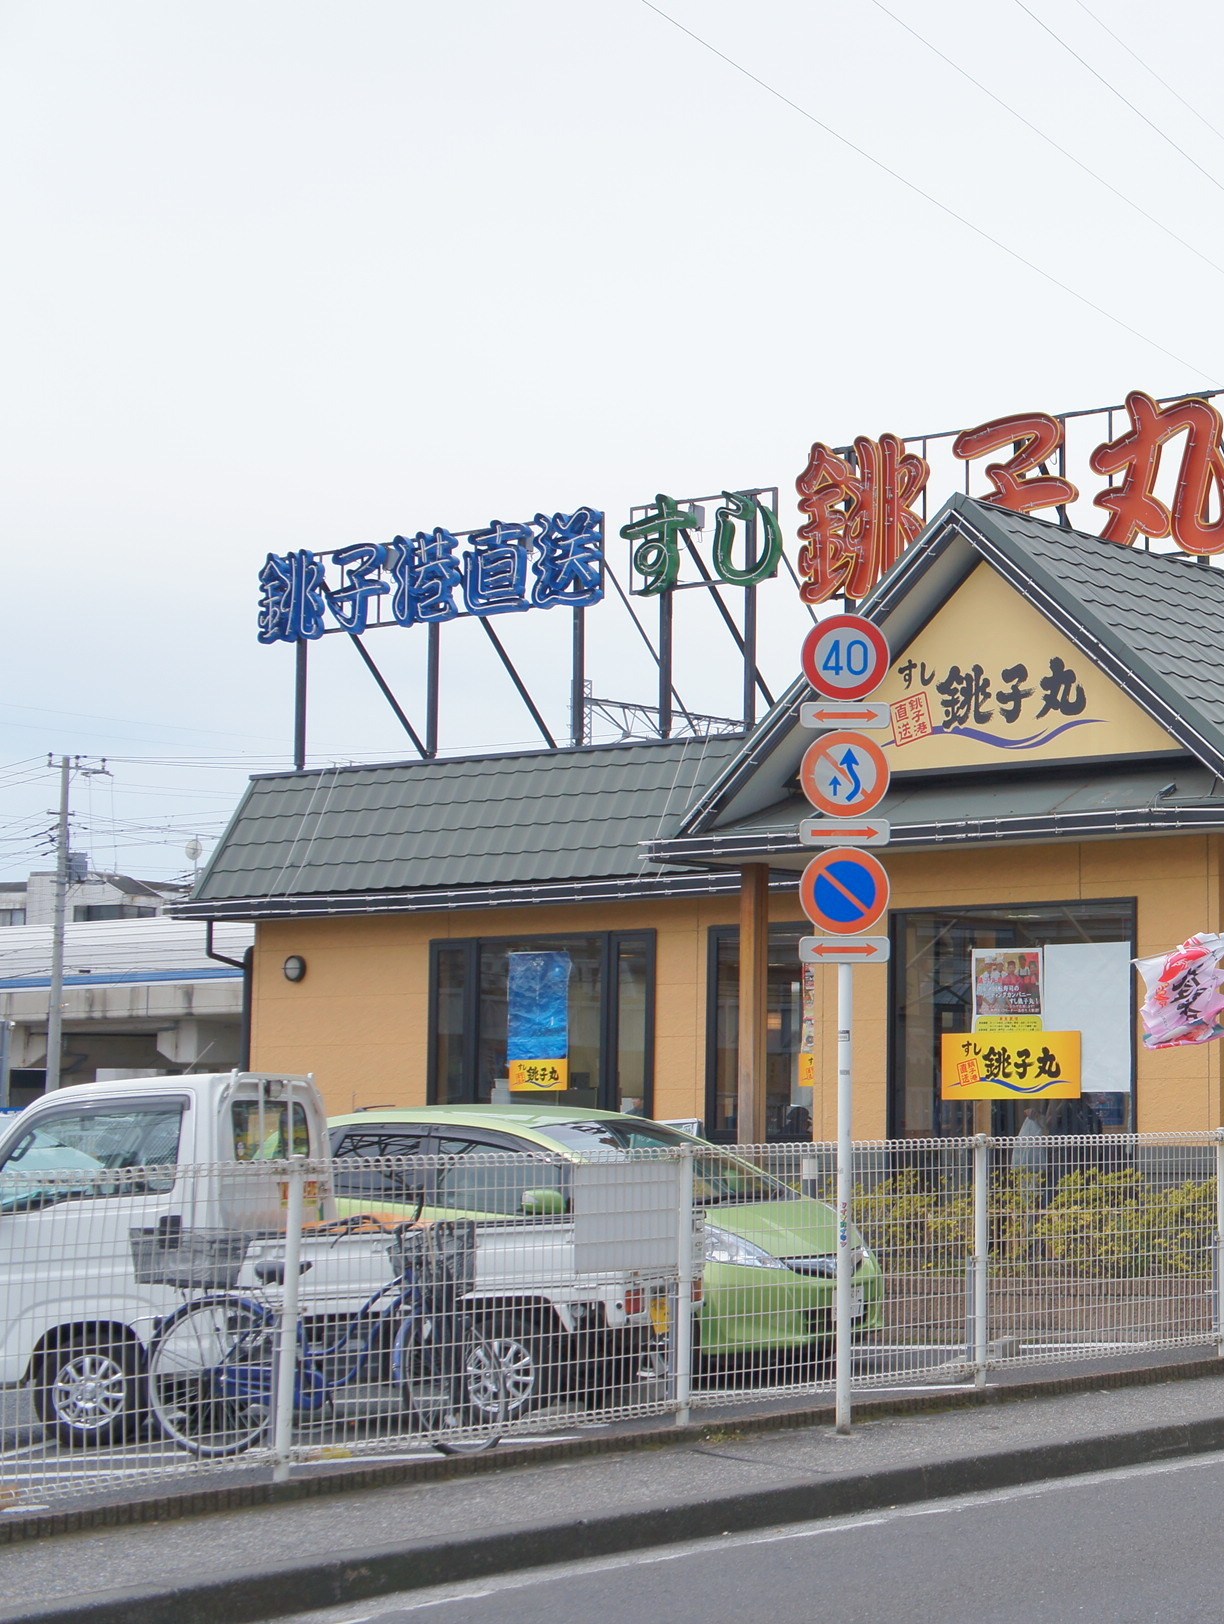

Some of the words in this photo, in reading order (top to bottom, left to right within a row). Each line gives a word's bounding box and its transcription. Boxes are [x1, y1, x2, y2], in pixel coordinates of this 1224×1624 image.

[257, 506, 604, 644] 銚子港直送
[618, 490, 783, 596] すし
[822, 639, 869, 676] 40
[898, 659, 936, 690] すし
[936, 656, 1087, 730] 銚子丸
[894, 703, 913, 741] 直送
[909, 697, 928, 736] 銚子港
[526, 1066, 560, 1082] 銚子丸
[961, 1040, 982, 1057] すし
[982, 1046, 1061, 1081] 銚子丸
